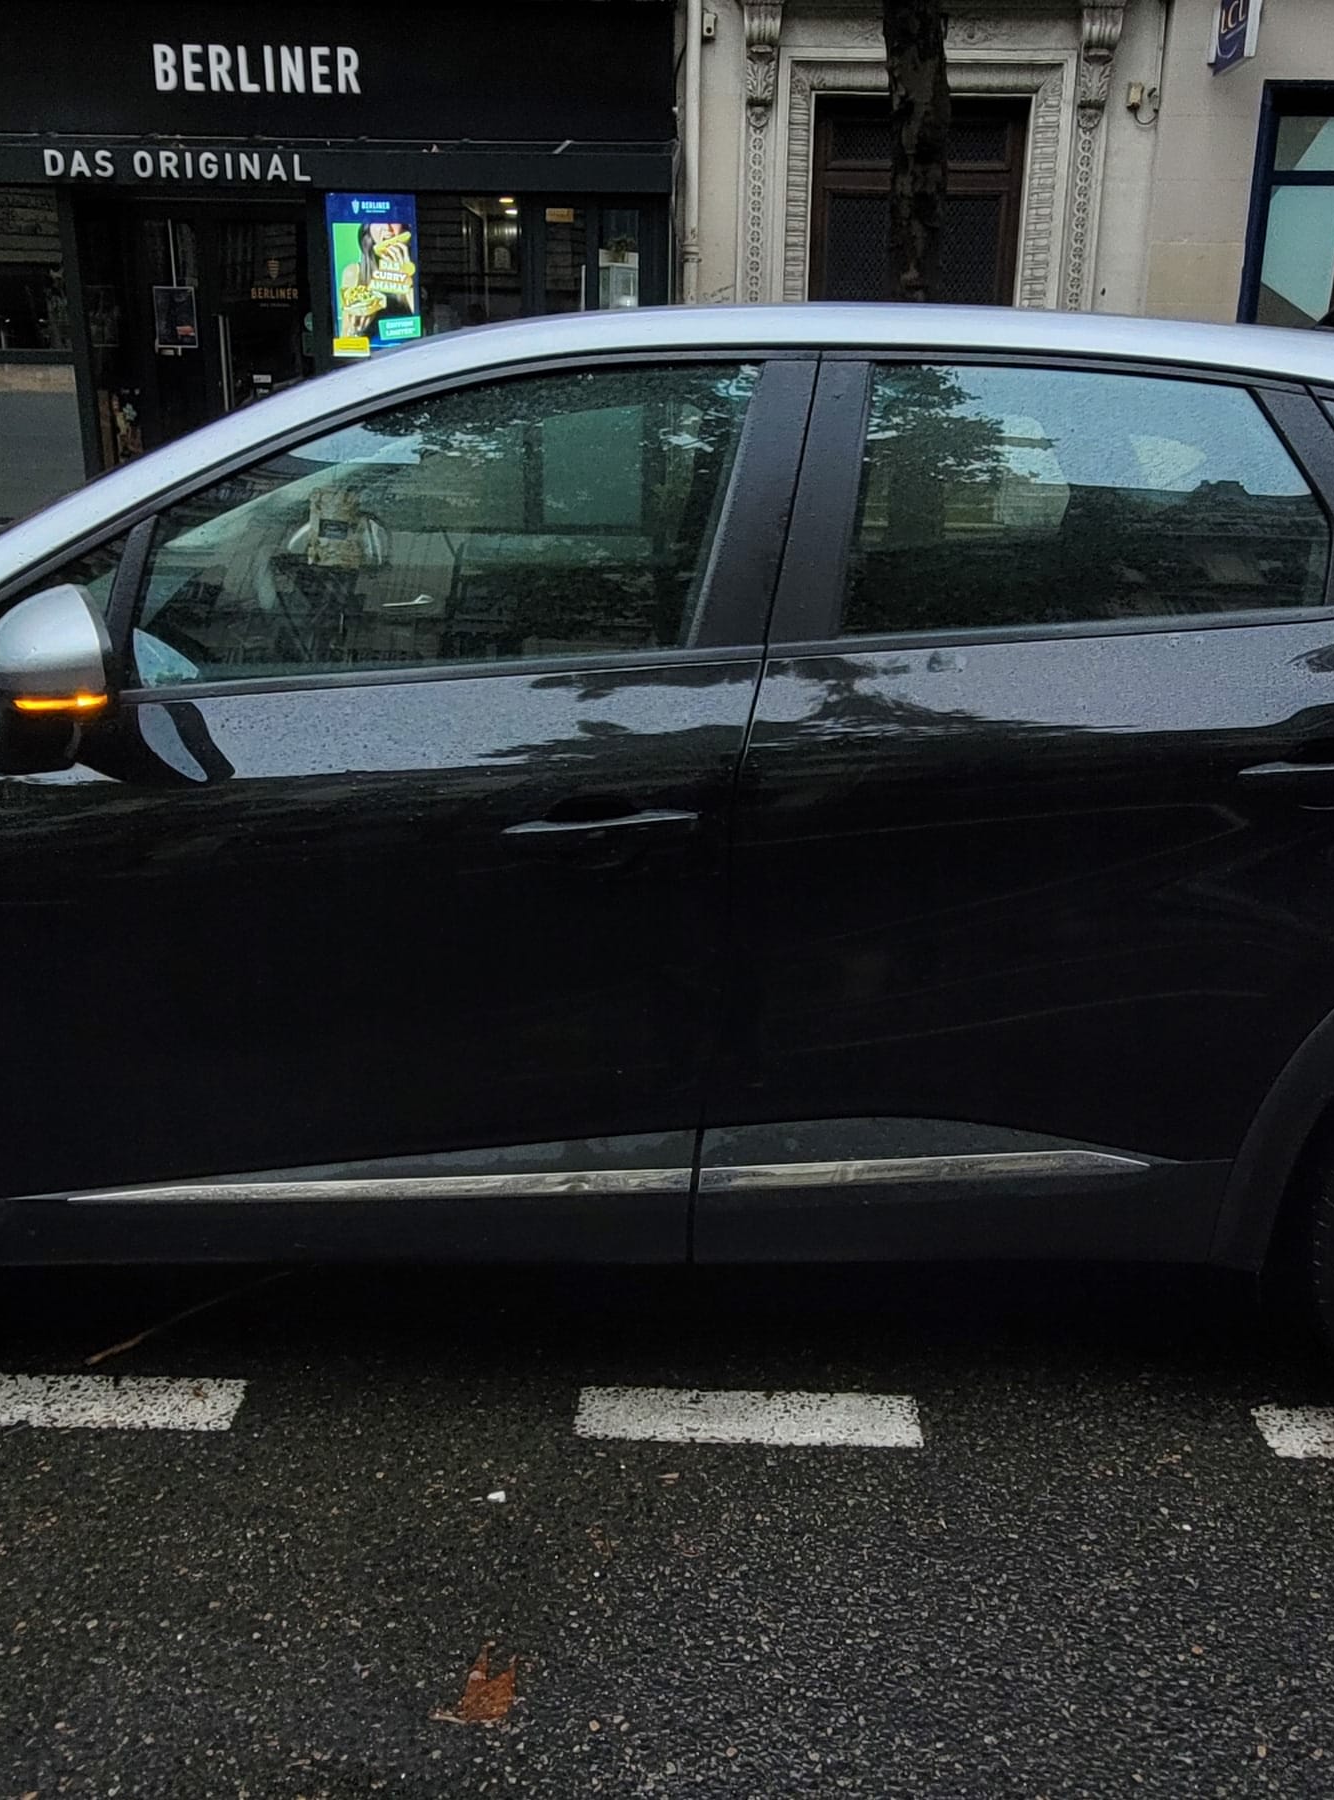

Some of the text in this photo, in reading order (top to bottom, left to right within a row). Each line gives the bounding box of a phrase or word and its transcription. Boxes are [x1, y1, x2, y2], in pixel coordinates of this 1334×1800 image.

[1220, 0, 1247, 34] LCL
[152, 43, 362, 94] BERLINER
[43, 149, 312, 182] DAS ORIGINAL
[372, 270, 407, 282] CURRY
[251, 287, 299, 300] BERLINER
